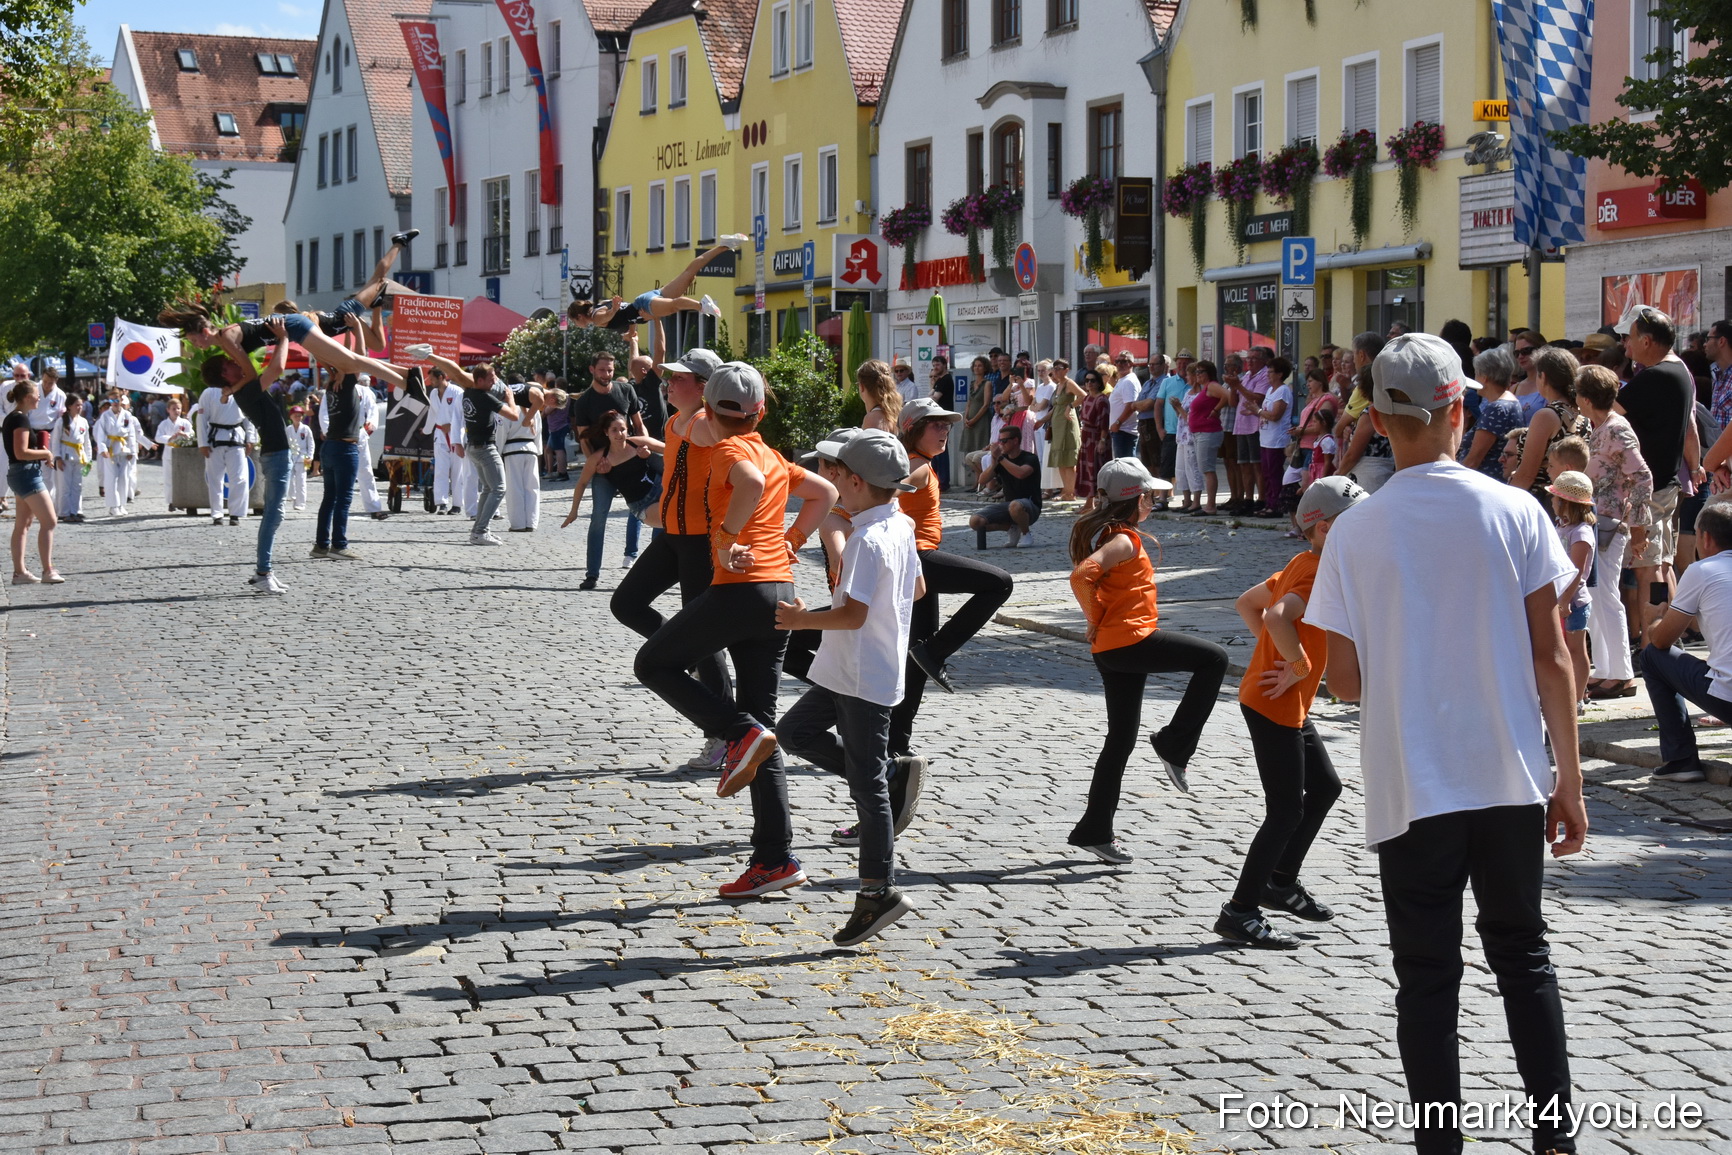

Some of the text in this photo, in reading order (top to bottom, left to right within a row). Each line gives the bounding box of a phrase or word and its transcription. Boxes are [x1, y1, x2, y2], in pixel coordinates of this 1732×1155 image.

[1483, 104, 1509, 118] KINO
[657, 136, 731, 171] HOTEL Lehmeier
[1666, 190, 1696, 206] DER
[1473, 208, 1503, 228] RIALTO
[1598, 204, 1618, 223] DER
[1270, 218, 1289, 233] MEHR
[771, 252, 802, 271] TAIFUN
[805, 247, 812, 276] P
[1290, 244, 1308, 279] P
[1223, 287, 1248, 303] WOLLE
[1256, 284, 1276, 300] MEHR
[398, 296, 460, 310] Traditionelles
[957, 304, 999, 316] RATHAUS APOTHEKE
[398, 306, 458, 319] Taekwon-Do
[897, 312, 914, 321] RATHAUS
[420, 318, 447, 326] Neumarkt
[958, 379, 966, 392] P
